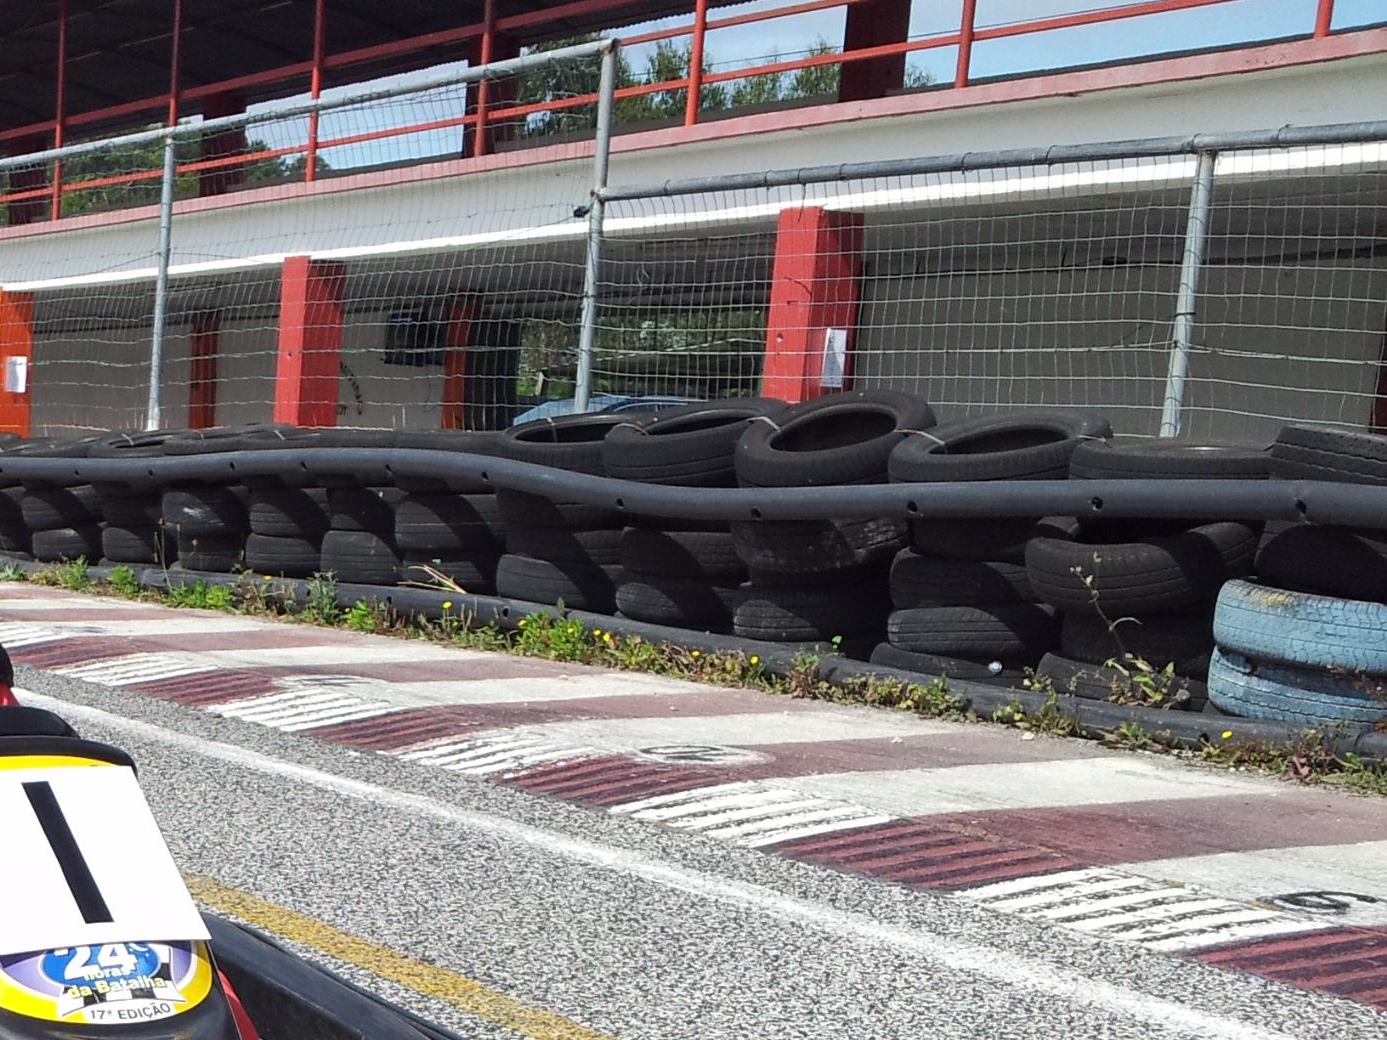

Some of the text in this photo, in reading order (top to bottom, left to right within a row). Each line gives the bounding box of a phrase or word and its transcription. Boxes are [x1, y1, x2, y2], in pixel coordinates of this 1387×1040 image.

[21, 780, 115, 925] 1
[64, 942, 139, 980] 24
[67, 975, 167, 1000] da Batalha
[117, 1001, 171, 1021] EDIÇÃO
